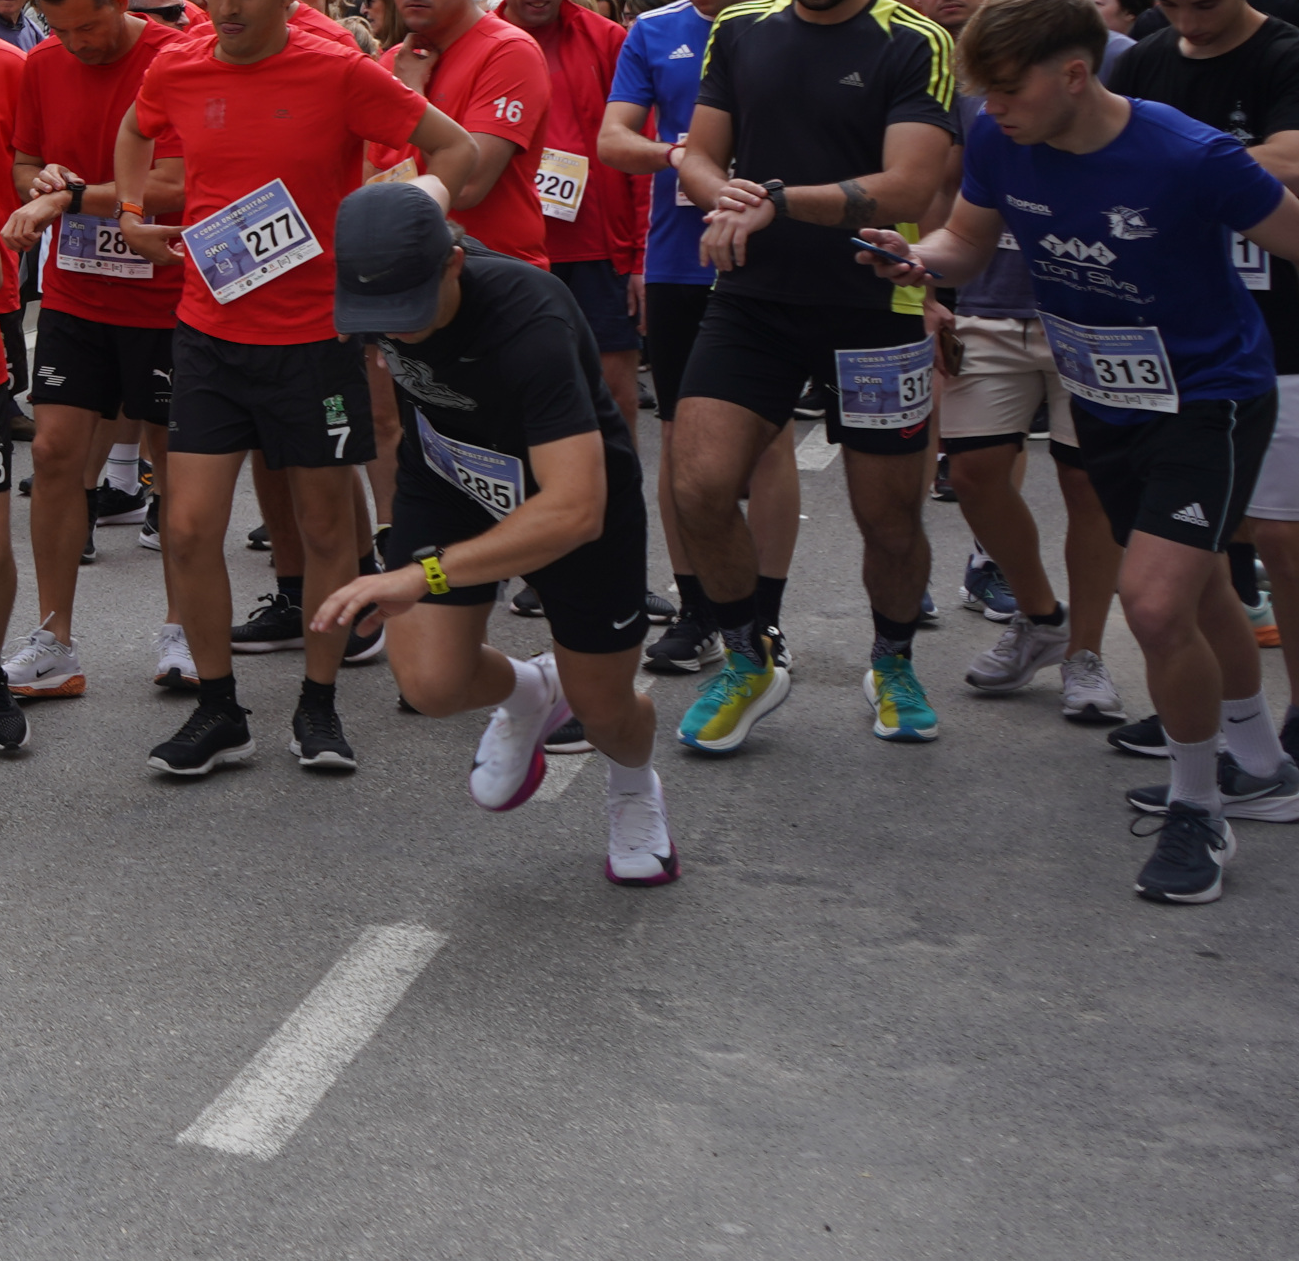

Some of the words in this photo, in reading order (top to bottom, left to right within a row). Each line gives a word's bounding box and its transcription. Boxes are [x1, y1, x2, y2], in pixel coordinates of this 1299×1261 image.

[492, 96, 524, 123] 16
[535, 173, 575, 200] 220
[68, 220, 86, 230] 5Km
[199, 221, 221, 236] CURSA
[245, 212, 295, 258] 277
[98, 228, 140, 256] 28
[204, 241, 229, 258] 5Km
[1034, 259, 1079, 280] Toni
[1086, 271, 1138, 294] Silva
[853, 375, 883, 384] 5Km
[1095, 358, 1161, 385] 313
[326, 426, 351, 459] 7
[457, 467, 512, 510] 285
[1171, 512, 1210, 528] adidas
